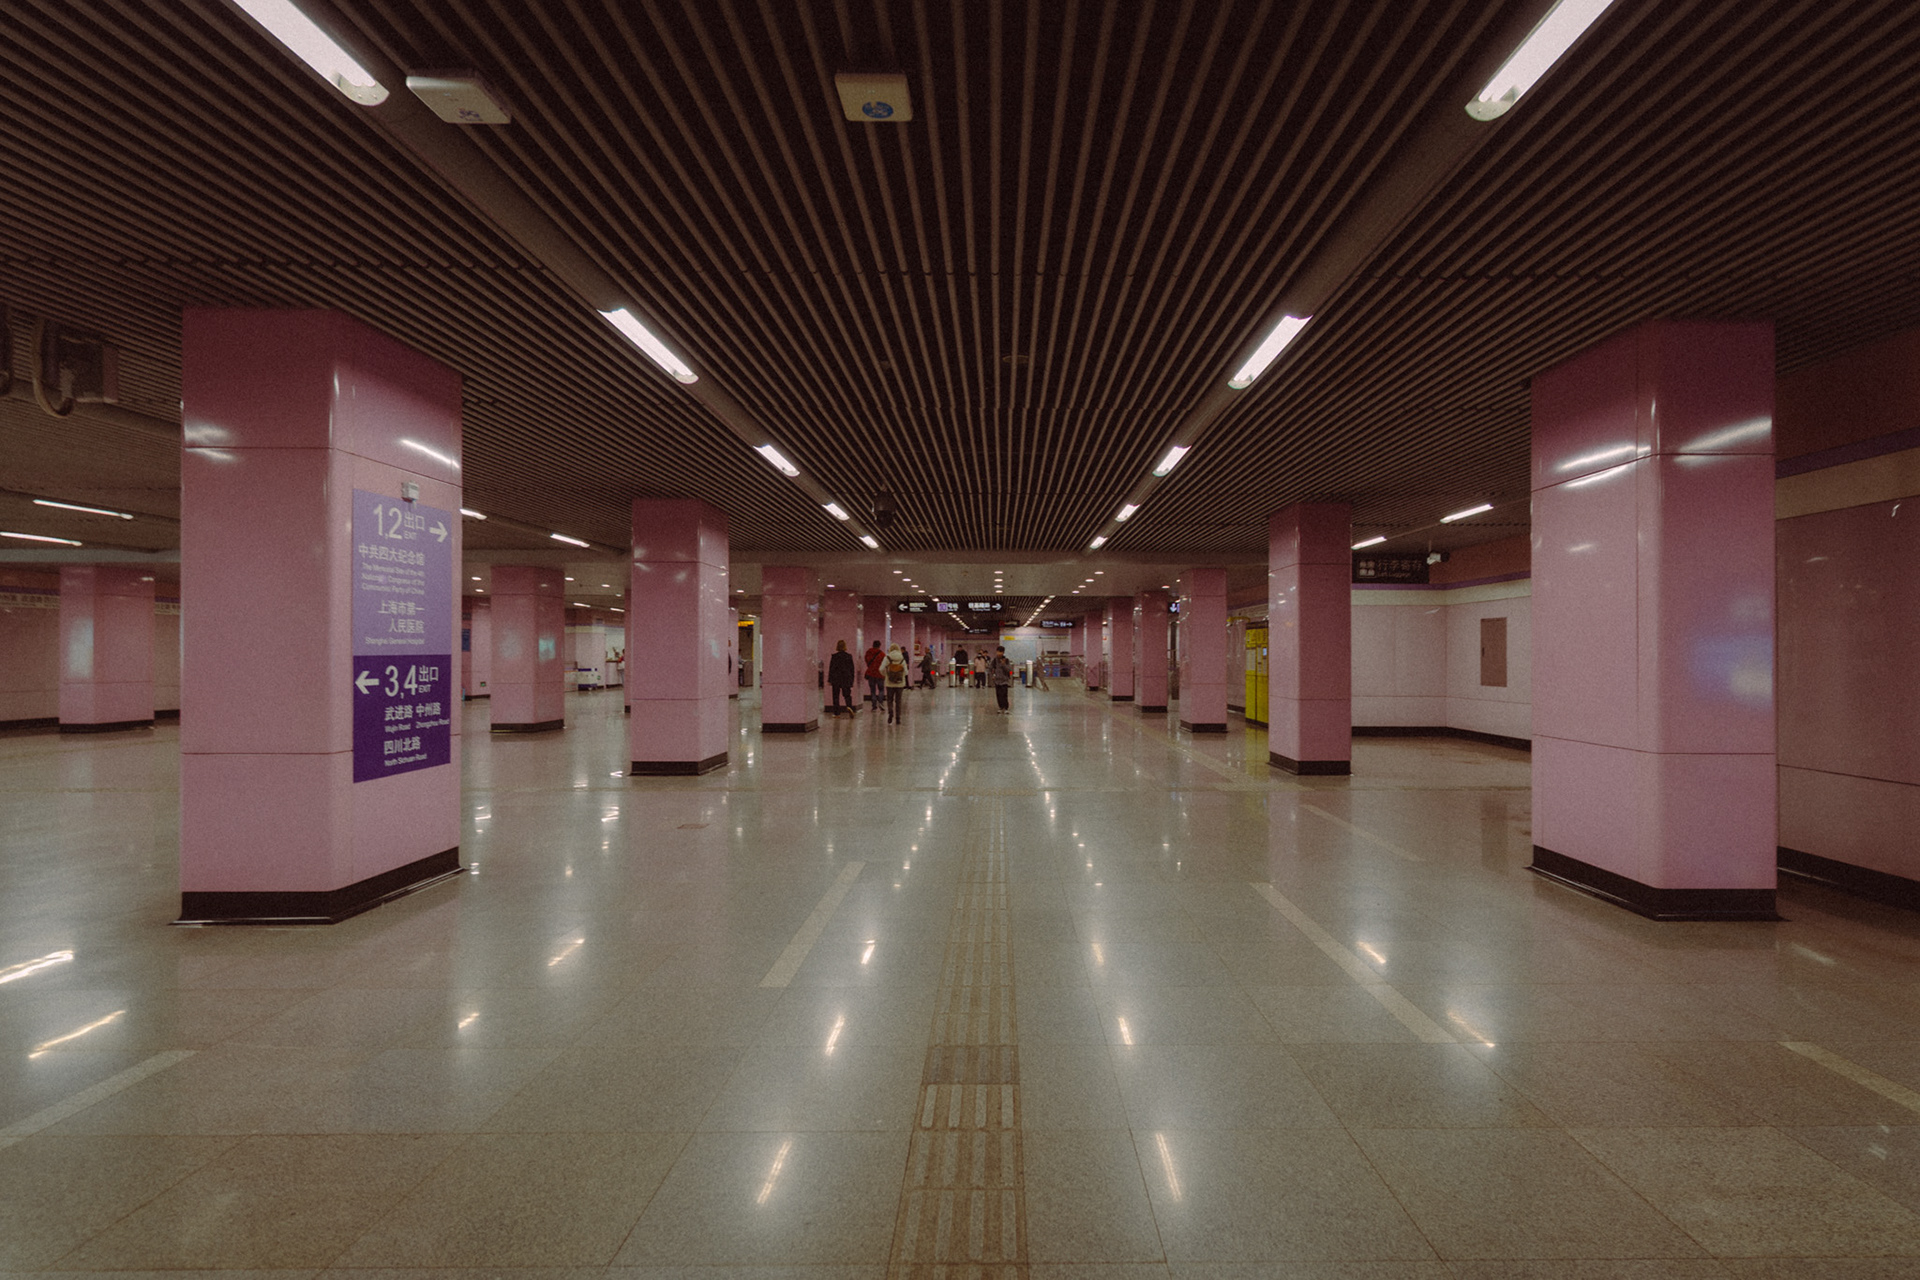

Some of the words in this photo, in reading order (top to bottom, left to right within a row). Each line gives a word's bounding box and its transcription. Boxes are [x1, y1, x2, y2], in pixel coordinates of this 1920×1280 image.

[373, 504, 402, 540] 1,2
[403, 512, 425, 531] 出口
[359, 542, 426, 566] 中共四大纪念馆
[377, 600, 425, 615] 上海市第一
[388, 618, 425, 633] 人民医院
[384, 664, 417, 699] 3,4
[418, 665, 439, 682] 出口
[384, 704, 413, 721] 武进路
[415, 702, 441, 717] 中州路
[384, 736, 421, 755] 四川北路
